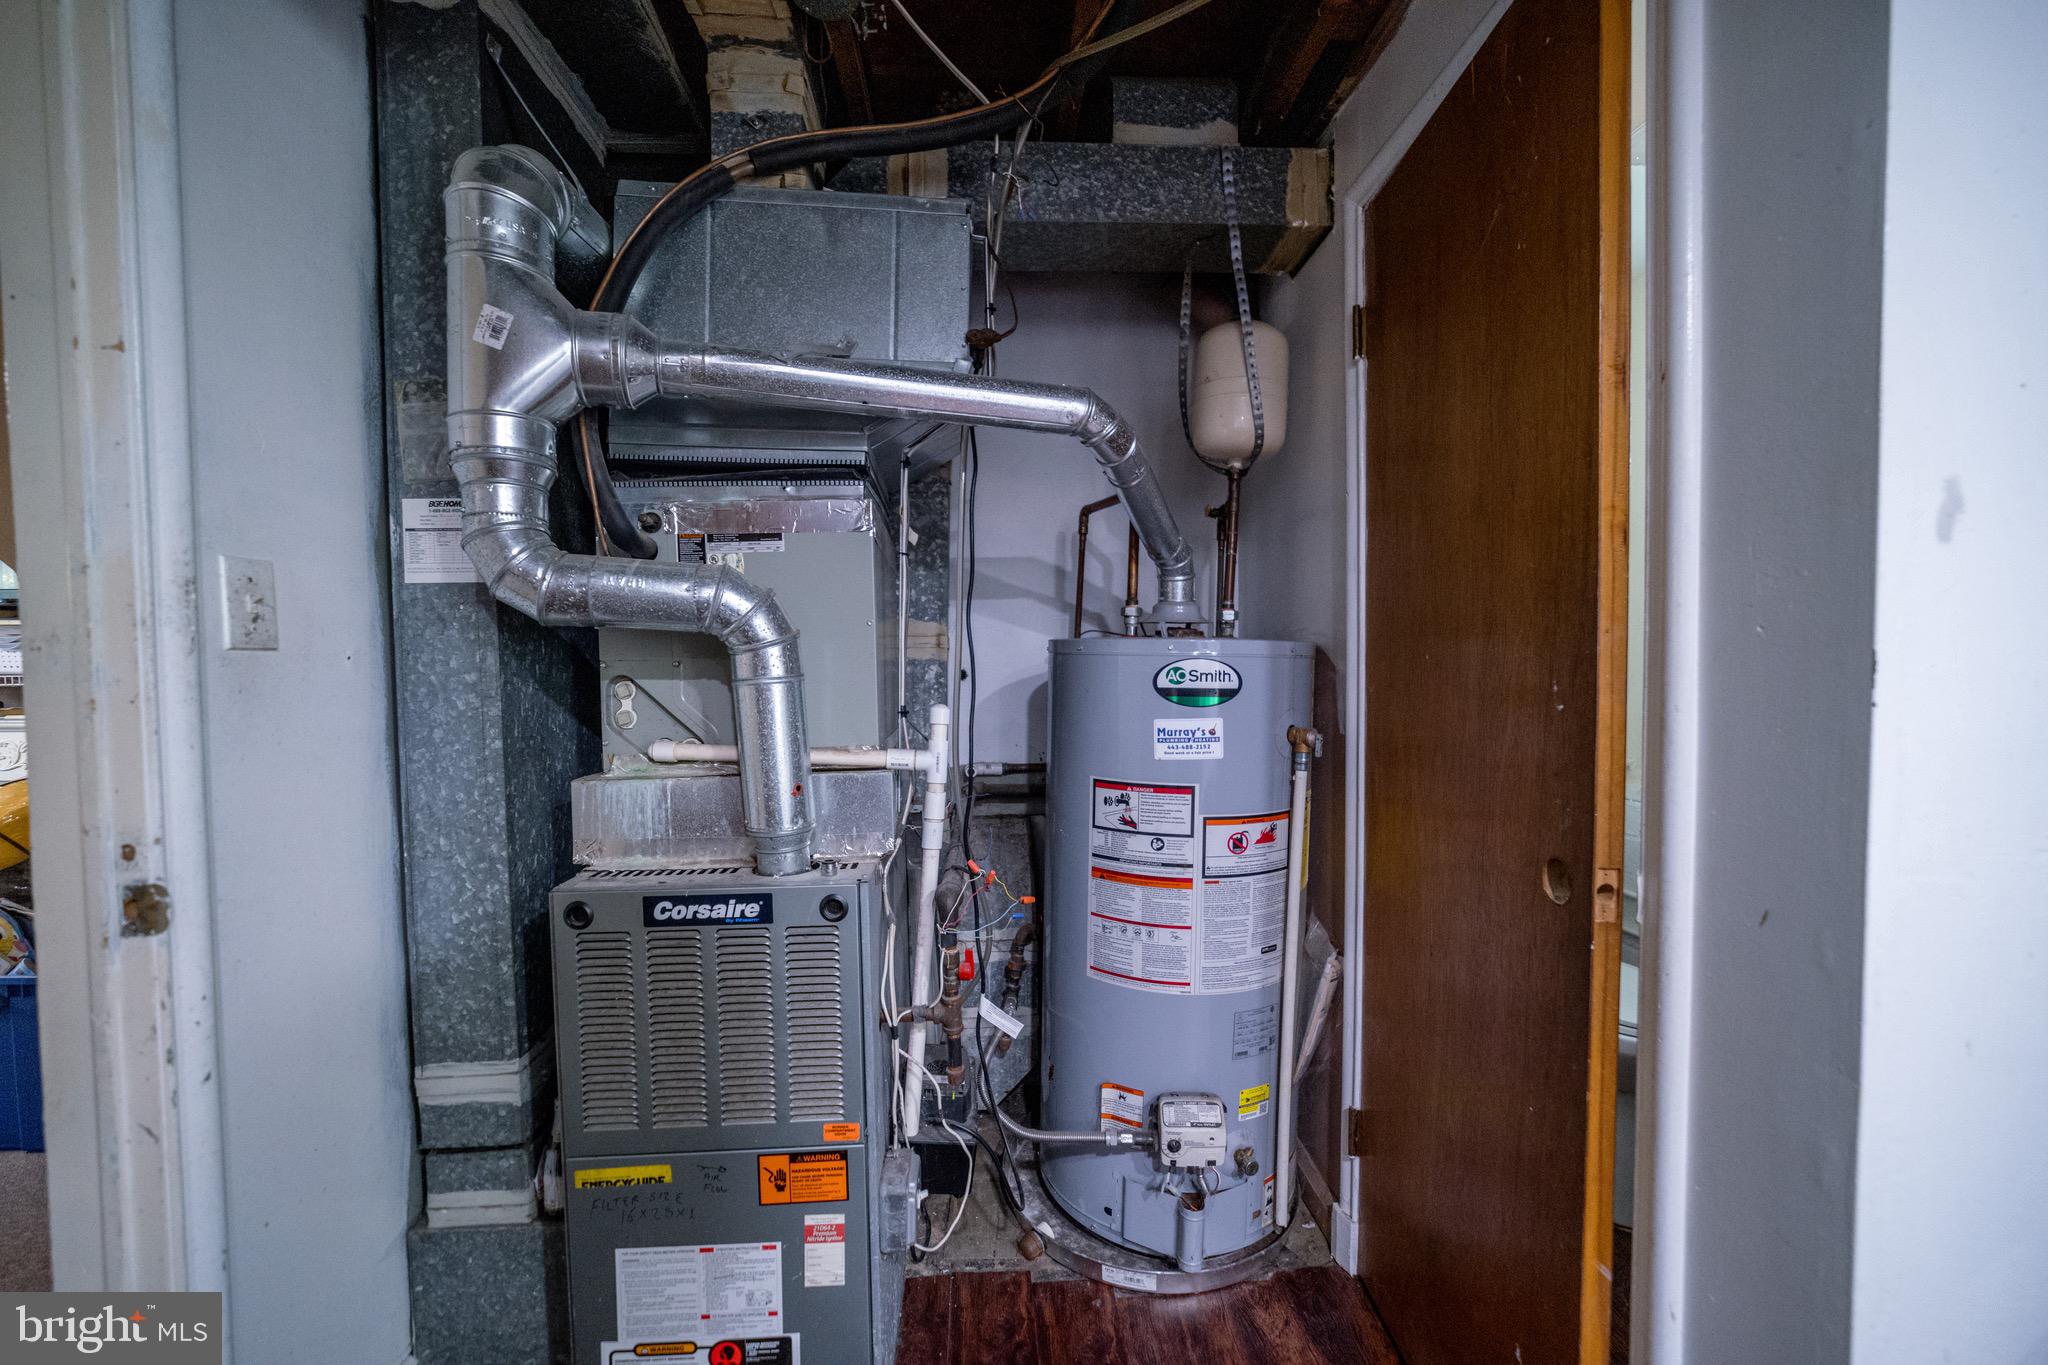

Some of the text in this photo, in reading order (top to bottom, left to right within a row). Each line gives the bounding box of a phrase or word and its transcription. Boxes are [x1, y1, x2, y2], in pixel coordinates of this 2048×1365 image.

[1188, 669, 1232, 683] Smith
[1157, 727, 1206, 738] Murray's
[653, 899, 761, 920] Corsaire
[803, 1153, 840, 1162] WARNING
